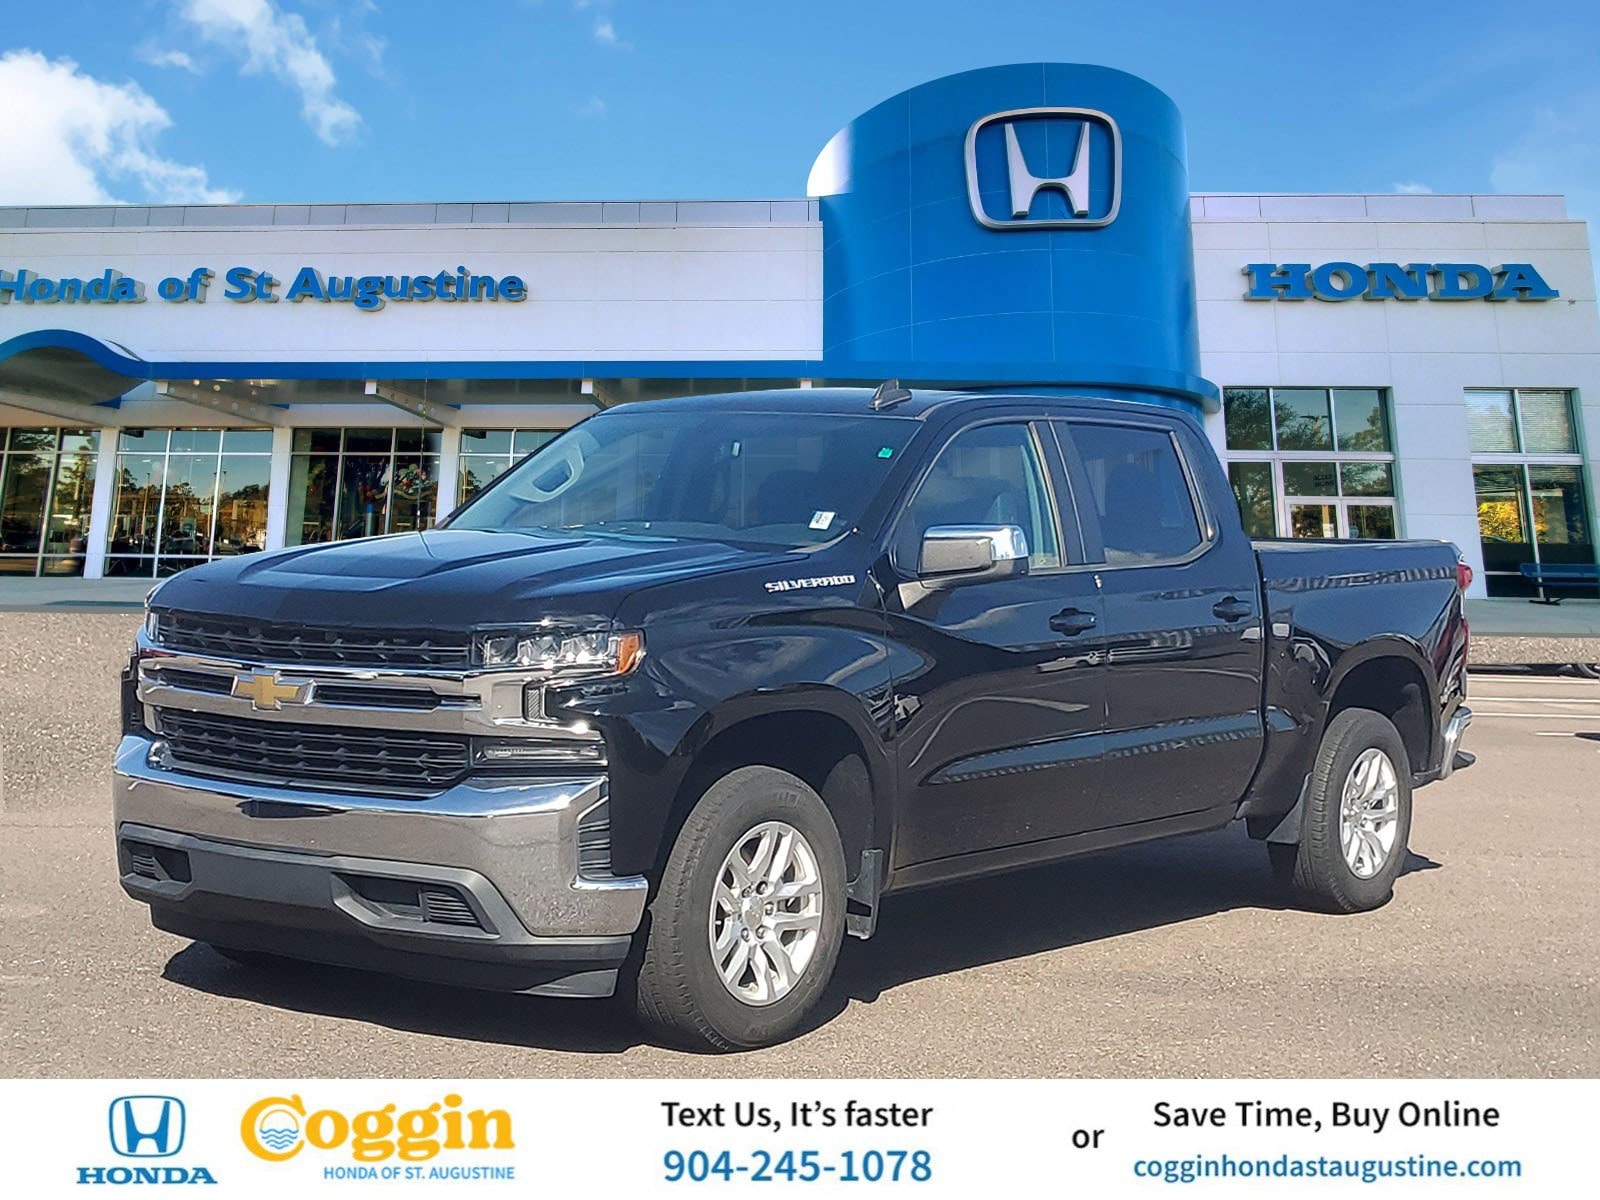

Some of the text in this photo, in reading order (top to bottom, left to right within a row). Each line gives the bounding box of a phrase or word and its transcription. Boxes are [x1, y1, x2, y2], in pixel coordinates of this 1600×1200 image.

[0, 264, 527, 310] Honda of St Augustine
[1243, 261, 1560, 301] HONDA
[764, 574, 857, 593] SILVERADO
